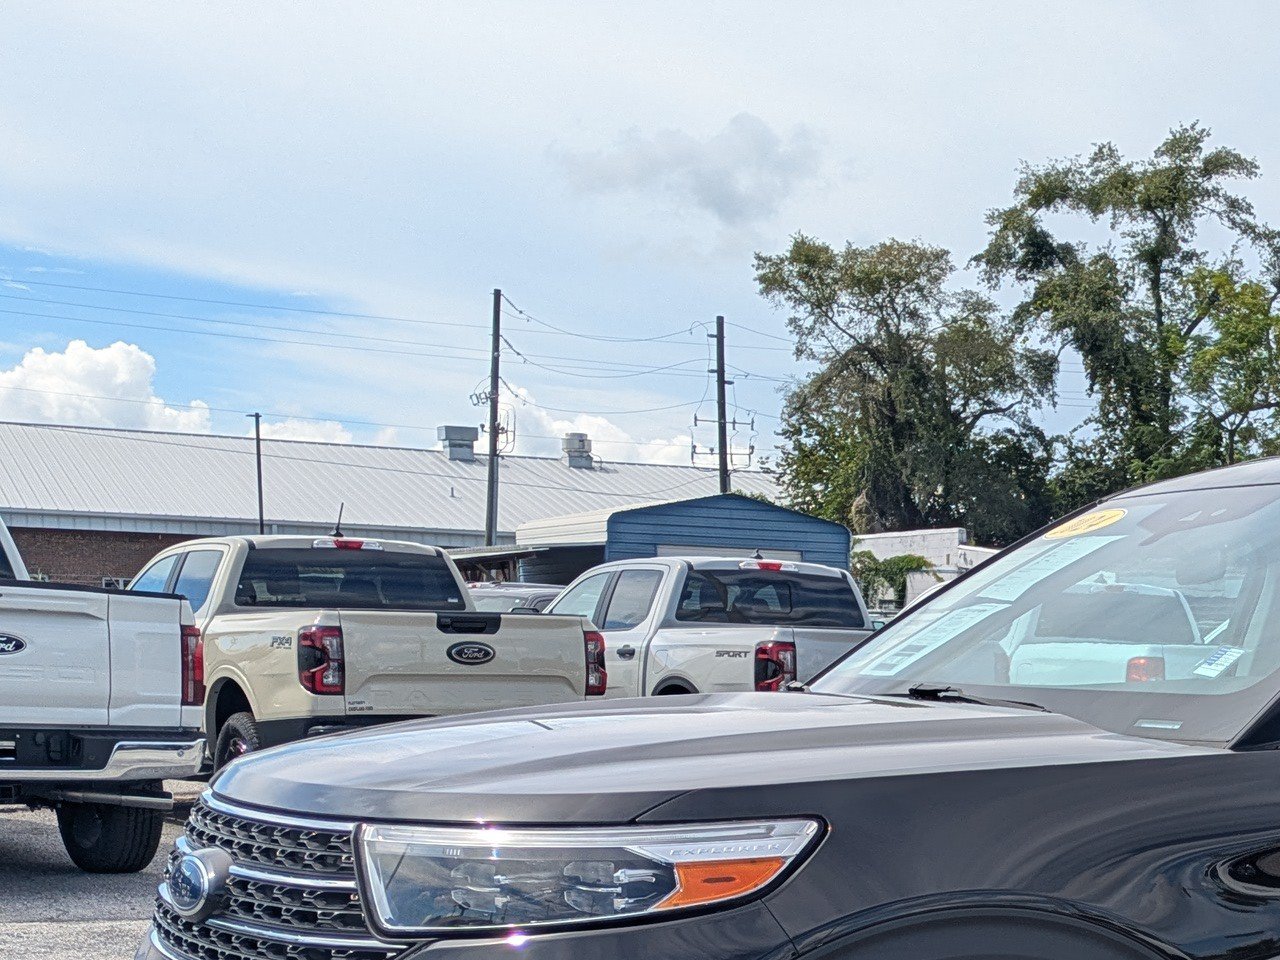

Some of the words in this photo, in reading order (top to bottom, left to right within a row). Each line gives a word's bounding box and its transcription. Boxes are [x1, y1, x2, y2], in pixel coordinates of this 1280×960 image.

[270, 636, 292, 647] FX4
[462, 648, 485, 658] Ford
[715, 650, 750, 658] SPORT
